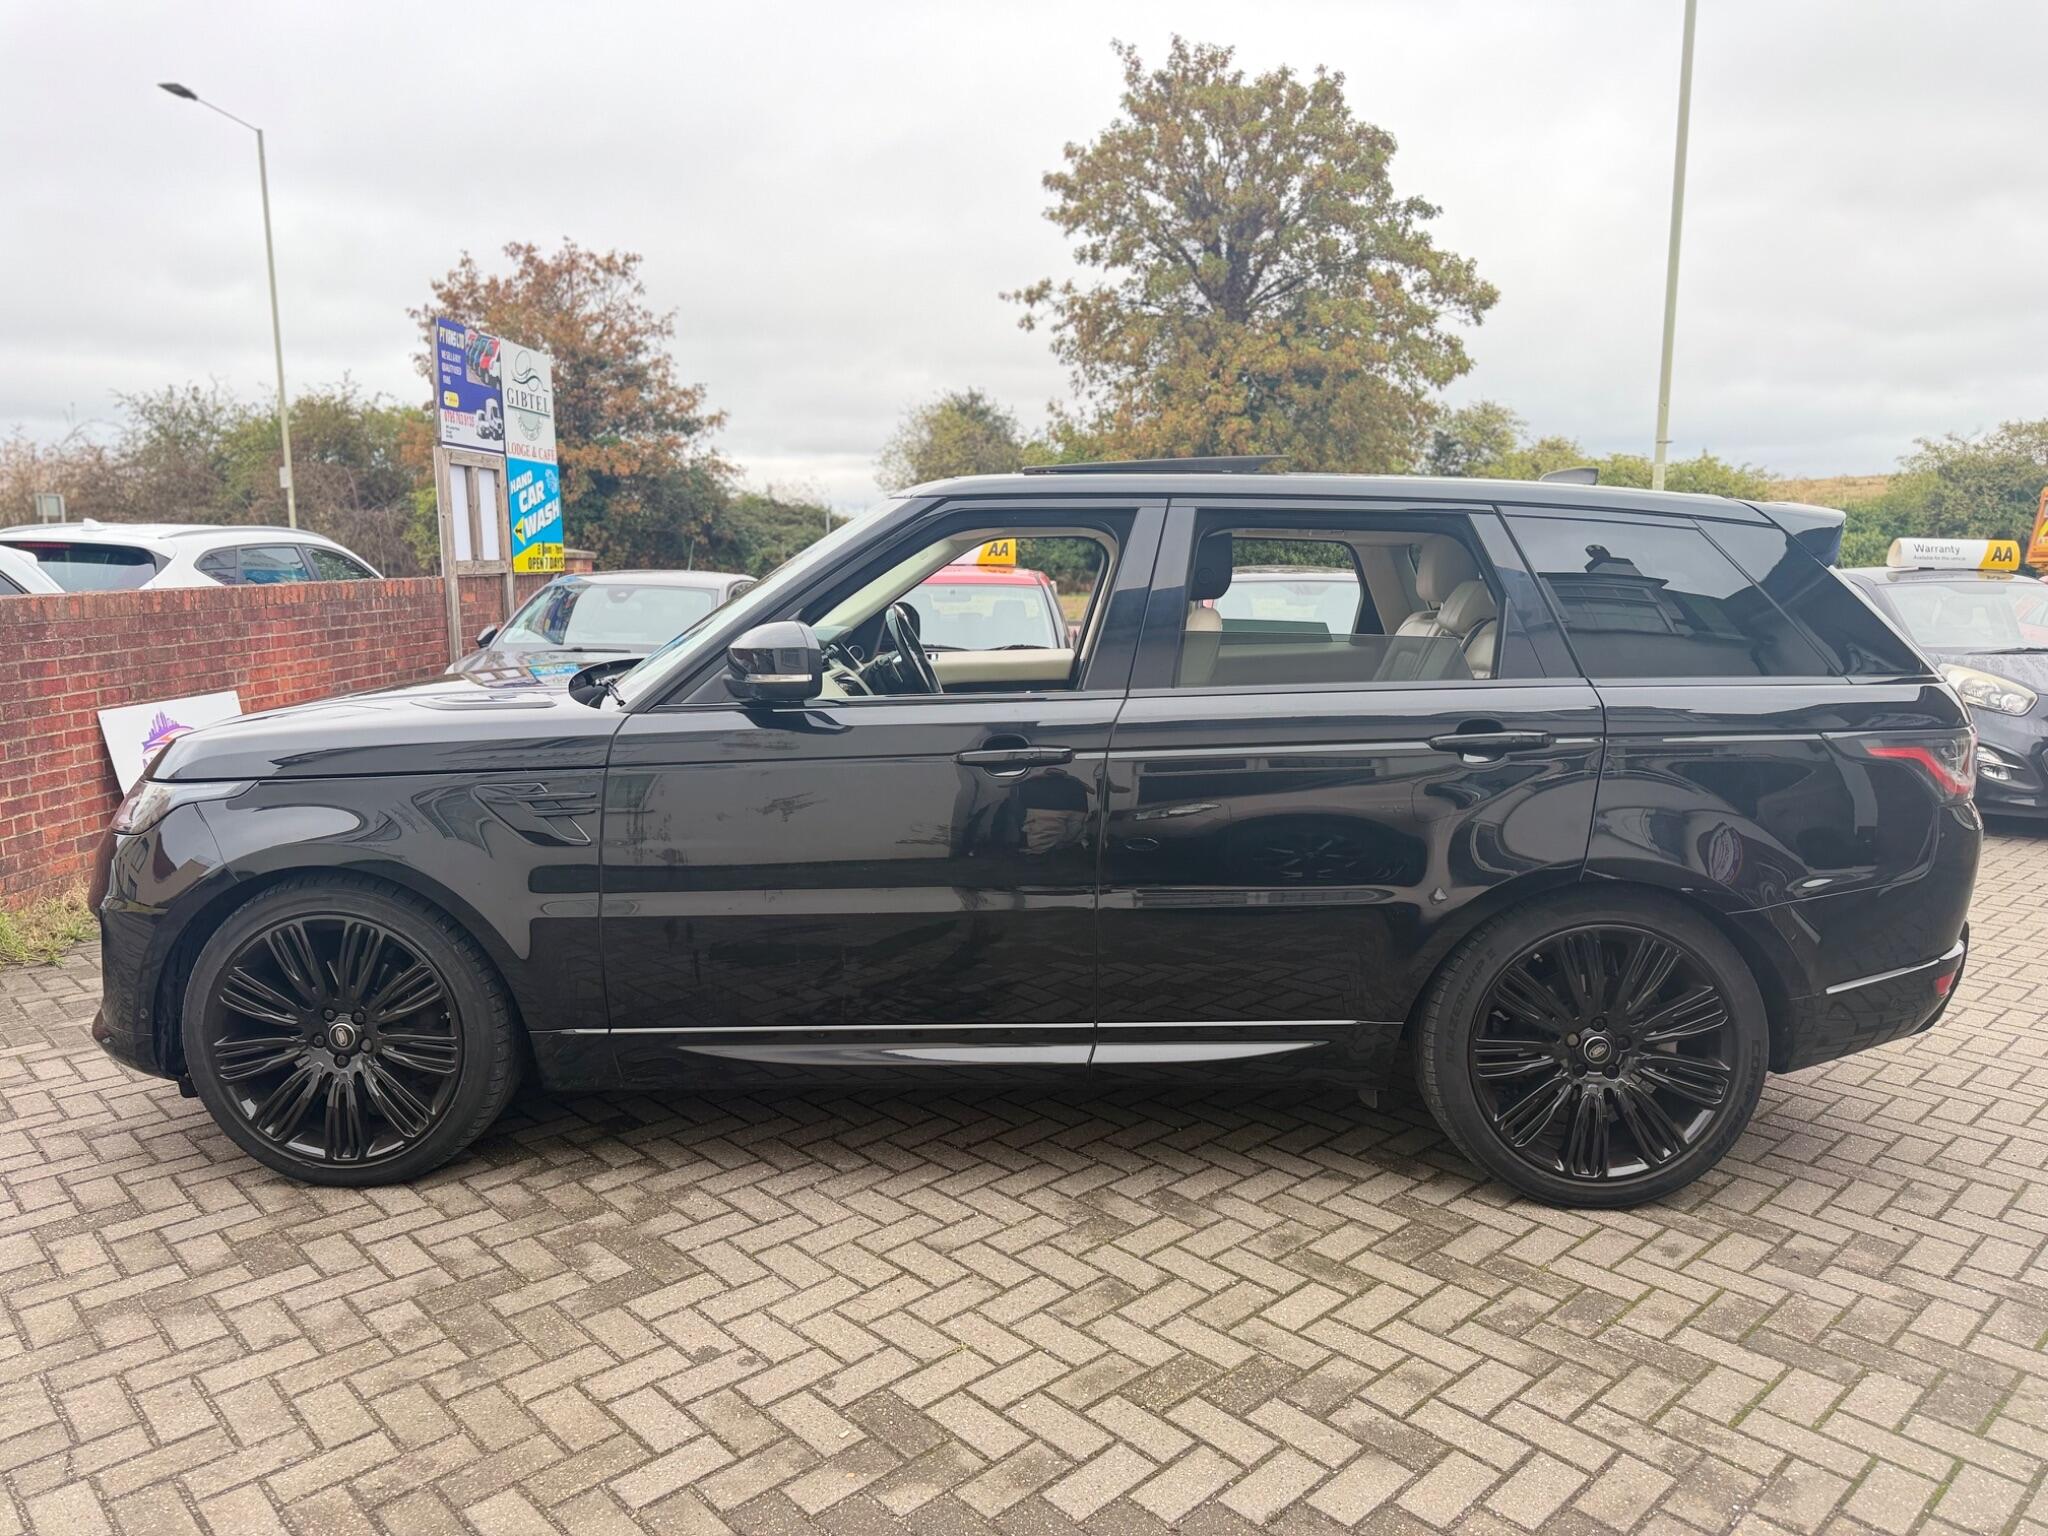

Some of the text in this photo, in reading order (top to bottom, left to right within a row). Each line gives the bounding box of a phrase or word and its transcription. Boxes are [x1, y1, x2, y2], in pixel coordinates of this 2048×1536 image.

[506, 387, 550, 413] GIBTEL
[507, 440, 531, 458] LODGE
[532, 446, 538, 458] &
[510, 469, 533, 495] HAND
[519, 480, 546, 514] CAR
[524, 497, 560, 539] WASH
[987, 542, 1009, 557] AA
[1913, 543, 1961, 556] Warranty
[1991, 546, 2013, 562] AA
[527, 556, 543, 570] OPEN
[549, 556, 564, 569] DAYS
